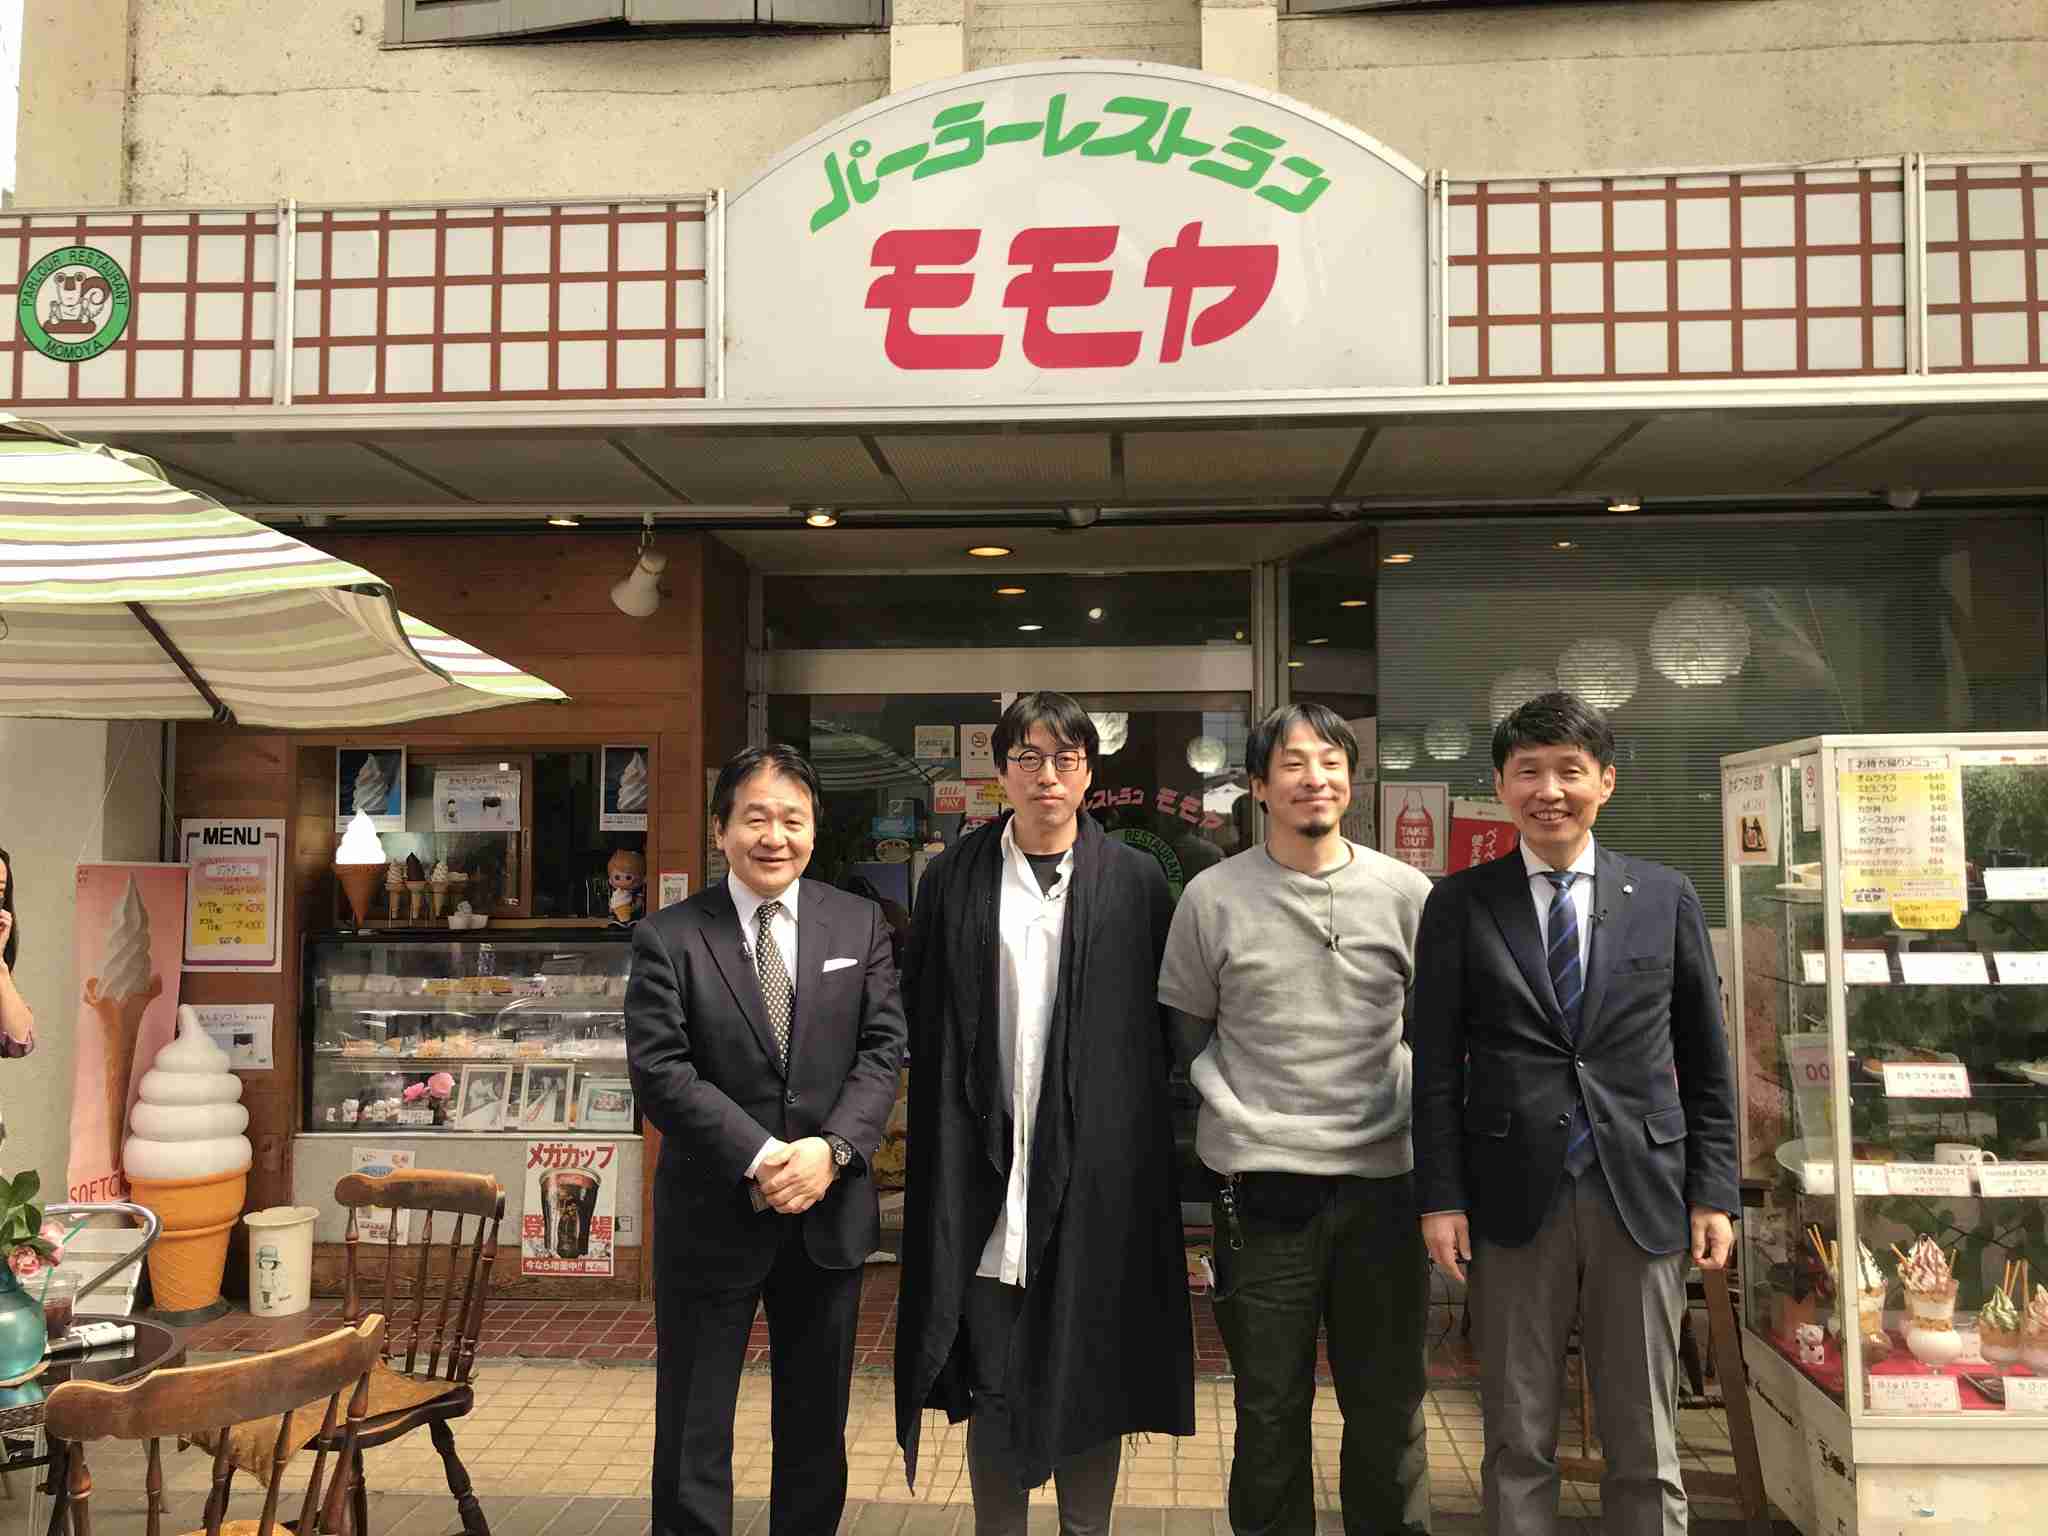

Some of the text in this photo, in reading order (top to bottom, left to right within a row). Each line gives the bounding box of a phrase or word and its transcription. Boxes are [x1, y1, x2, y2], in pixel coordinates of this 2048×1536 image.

[811, 93, 1333, 233] パーラーレストラン
[21, 250, 128, 307] PARLOUR RESTAURANT
[865, 221, 1280, 371] モモヤ
[43, 339, 105, 358] MOMOYA
[1856, 757, 1938, 769] お持ち帰りメニュー
[1857, 774, 1897, 782] オムライス
[940, 798, 961, 808] PAY
[1858, 795, 1898, 803] チャーハン
[203, 826, 261, 845] MENU
[1399, 826, 1428, 837] TAKE
[1402, 837, 1427, 847] OUT
[1123, 831, 1183, 882] RESTAURANT
[527, 1143, 616, 1169] メガカップ
